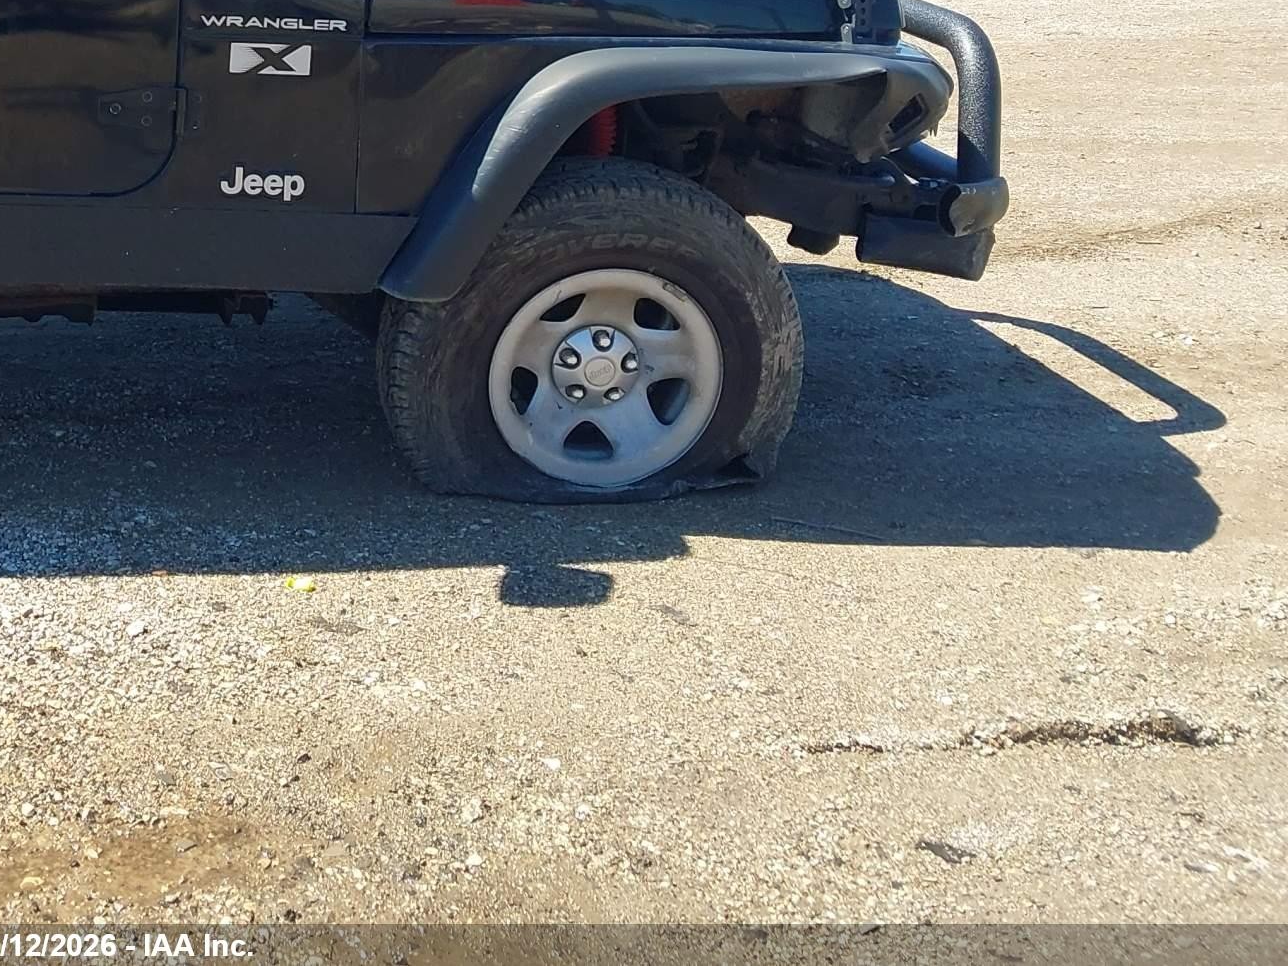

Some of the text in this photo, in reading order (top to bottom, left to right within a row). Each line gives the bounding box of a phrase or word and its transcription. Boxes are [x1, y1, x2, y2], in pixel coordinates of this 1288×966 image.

[200, 15, 347, 31] WRANGLER
[235, 43, 306, 75] X
[220, 167, 305, 201] Jeep
